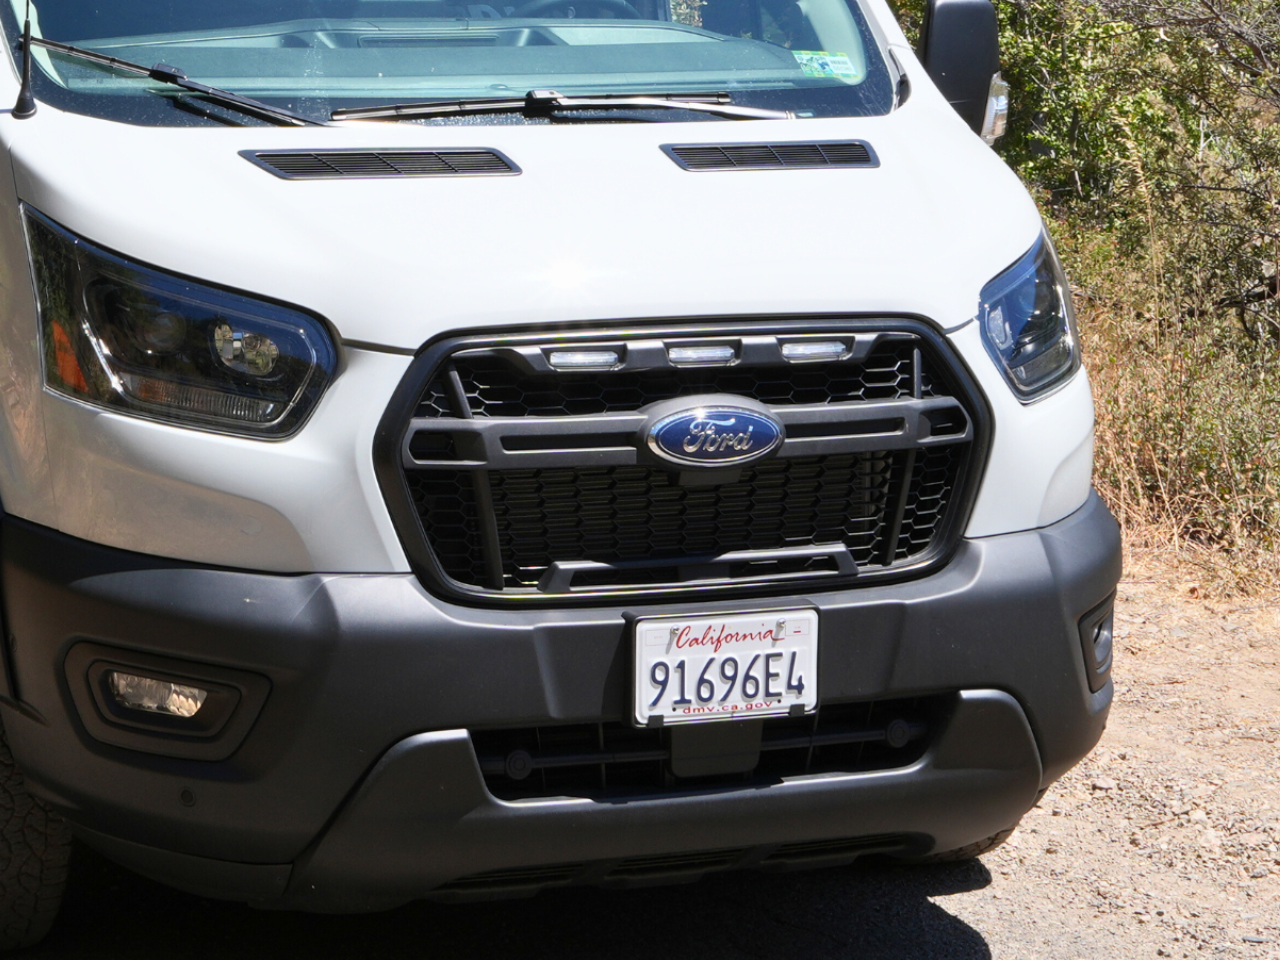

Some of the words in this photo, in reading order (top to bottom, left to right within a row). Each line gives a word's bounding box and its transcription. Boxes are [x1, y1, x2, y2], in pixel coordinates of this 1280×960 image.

[683, 417, 754, 453] Ford
[675, 623, 785, 653] California
[649, 650, 805, 708] 91696E4
[682, 700, 774, 715] dmv.ca.gov
